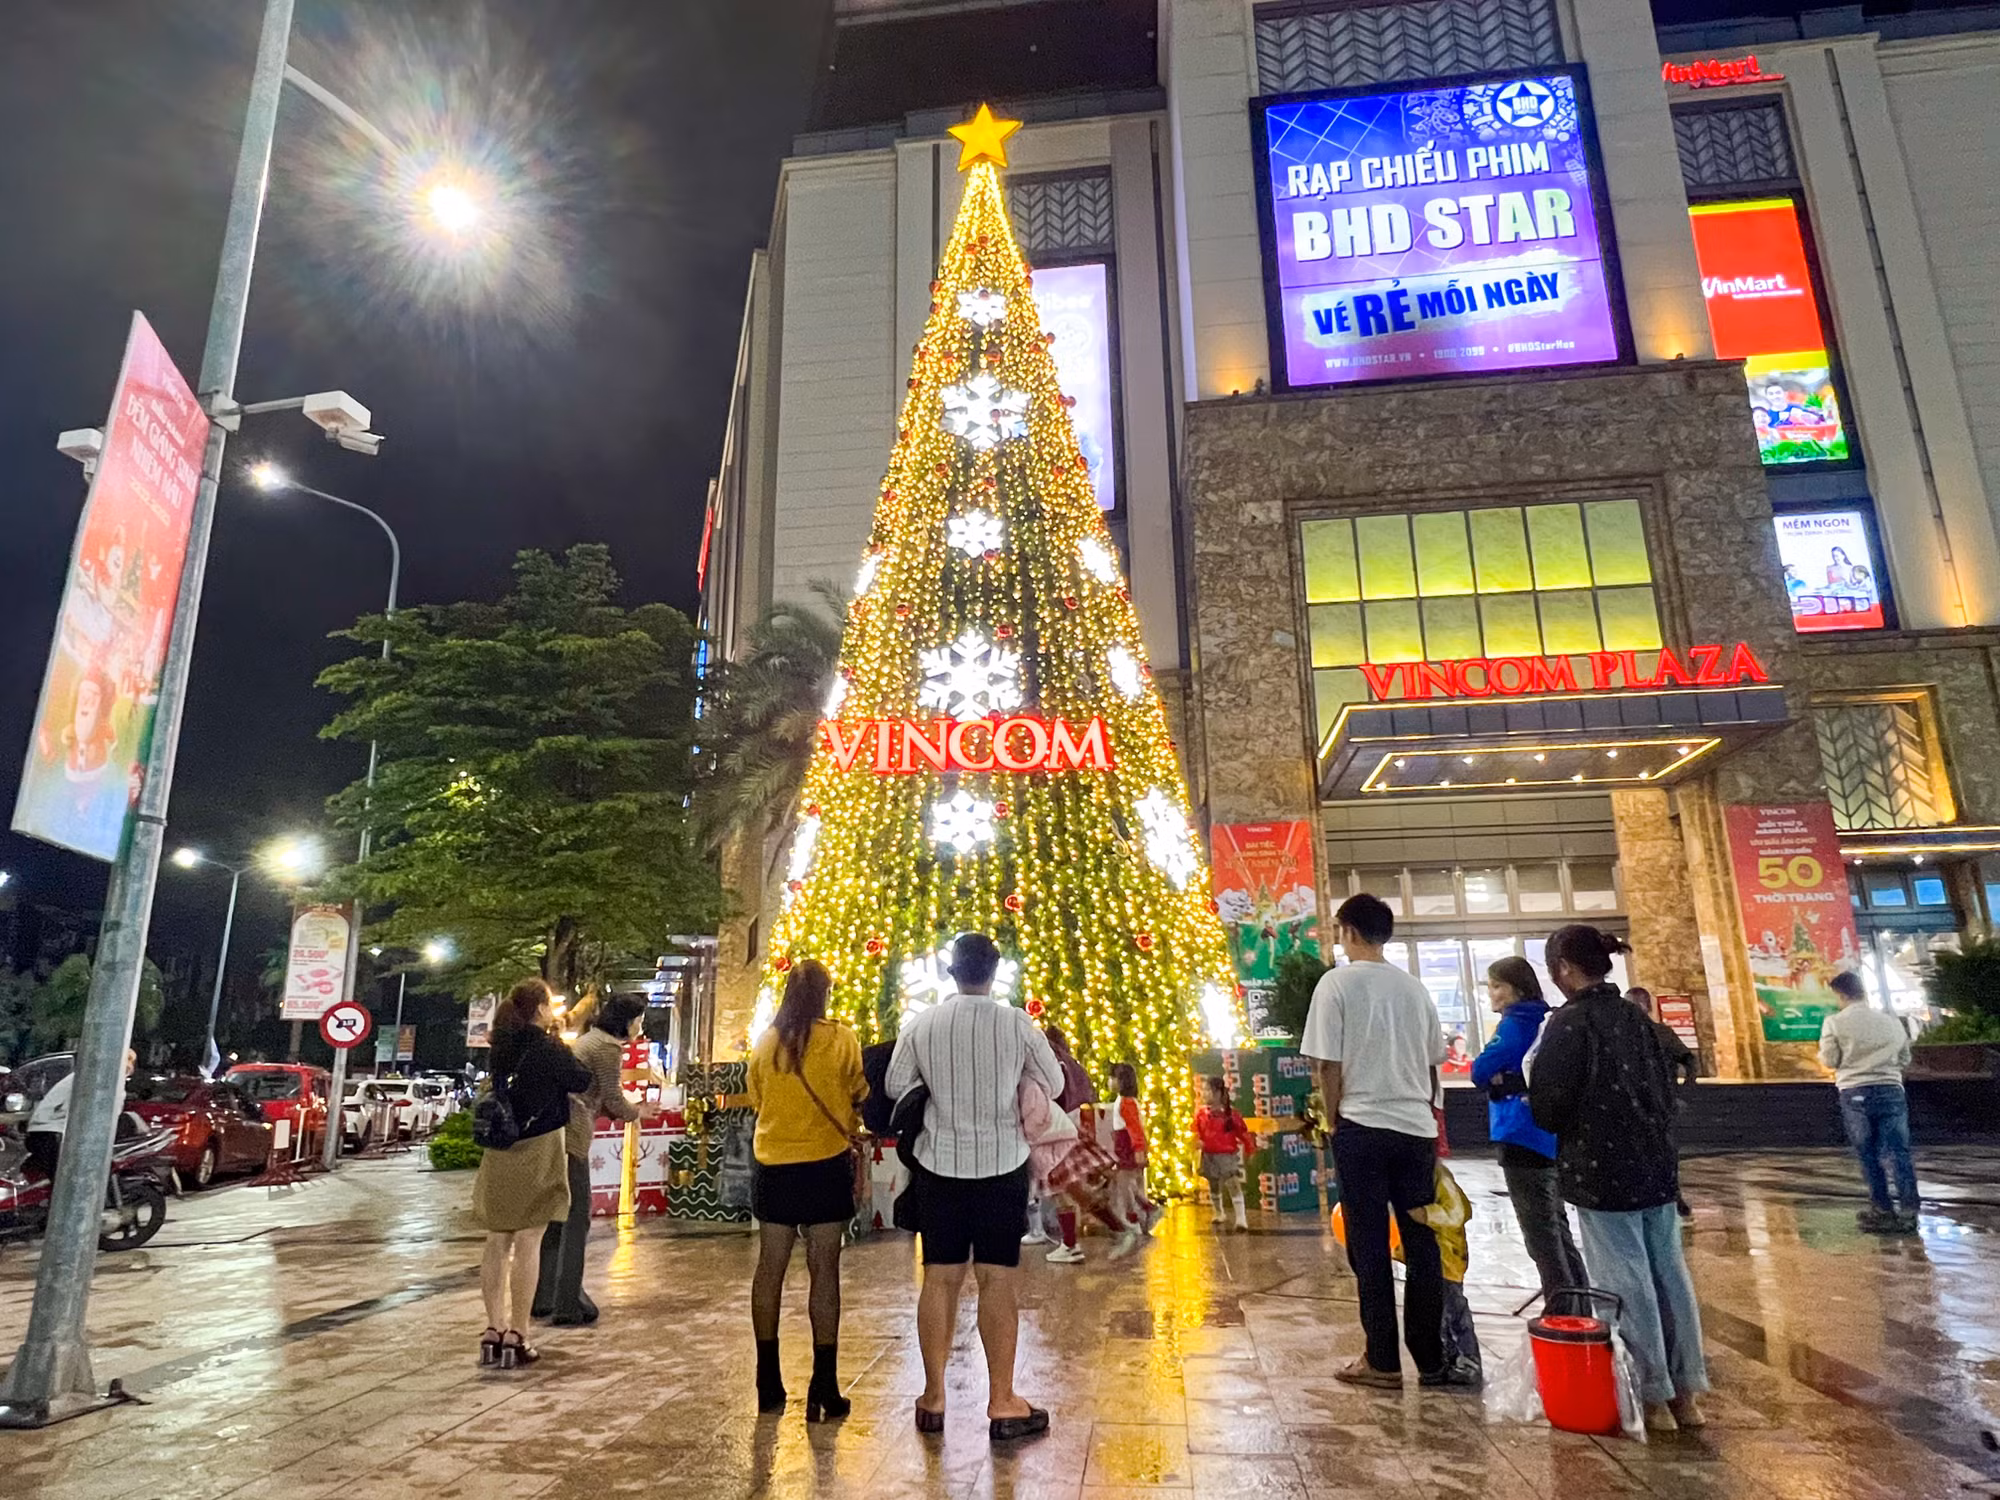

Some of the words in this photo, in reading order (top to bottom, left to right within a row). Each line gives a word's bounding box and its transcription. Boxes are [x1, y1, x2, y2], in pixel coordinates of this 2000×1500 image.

[1287, 161, 1351, 200] RẠP
[1361, 140, 1458, 189] CHIẾU
[1466, 142, 1550, 179] PHIM
[1292, 204, 1413, 262] BHD
[1424, 189, 1576, 250] STAR
[1313, 301, 1352, 335] VÉ
[1353, 280, 1416, 337] RẺ
[1417, 279, 1478, 319] MỖI
[1483, 271, 1559, 309] NGÀY
[1814, 518, 1850, 528] NGON
[1360, 654, 1580, 701] VINCOM
[1588, 642, 1768, 689] PLAZA
[820, 716, 1114, 773] VINCOM
[1760, 808, 1796, 816] VINCOM
[1752, 891, 1786, 903] THỜI
[1787, 891, 1835, 903] TRANG
[1758, 855, 1824, 889] 50
